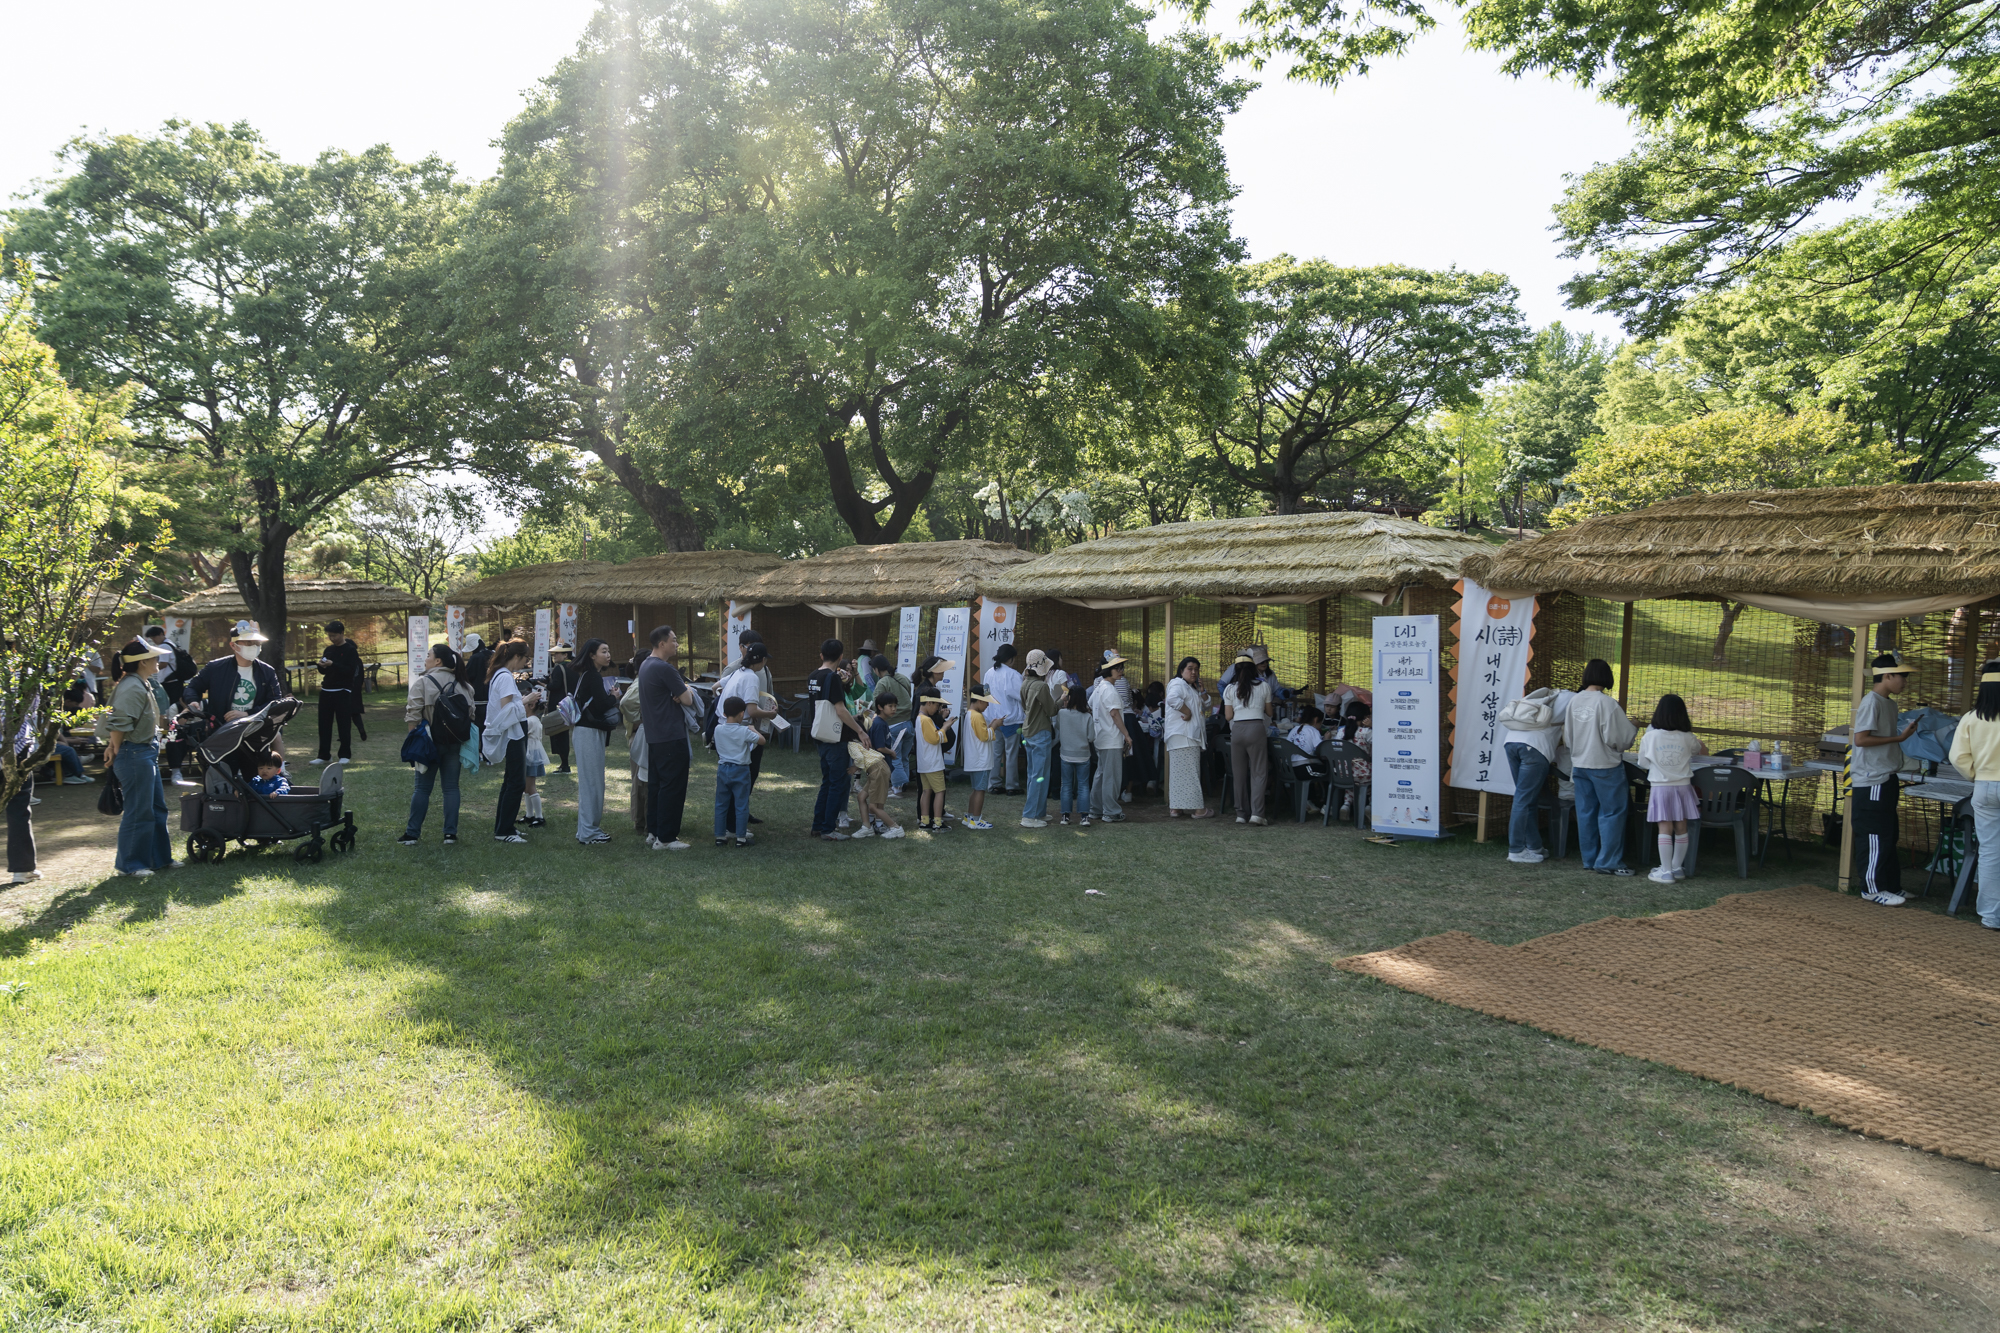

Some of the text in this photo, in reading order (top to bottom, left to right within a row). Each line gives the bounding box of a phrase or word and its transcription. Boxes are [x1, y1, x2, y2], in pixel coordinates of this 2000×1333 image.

[1394, 624, 1416, 638] [시]
[1475, 625, 1523, 646] 시(詩)
[1476, 652, 1501, 782] 내가 삼행시 최고
